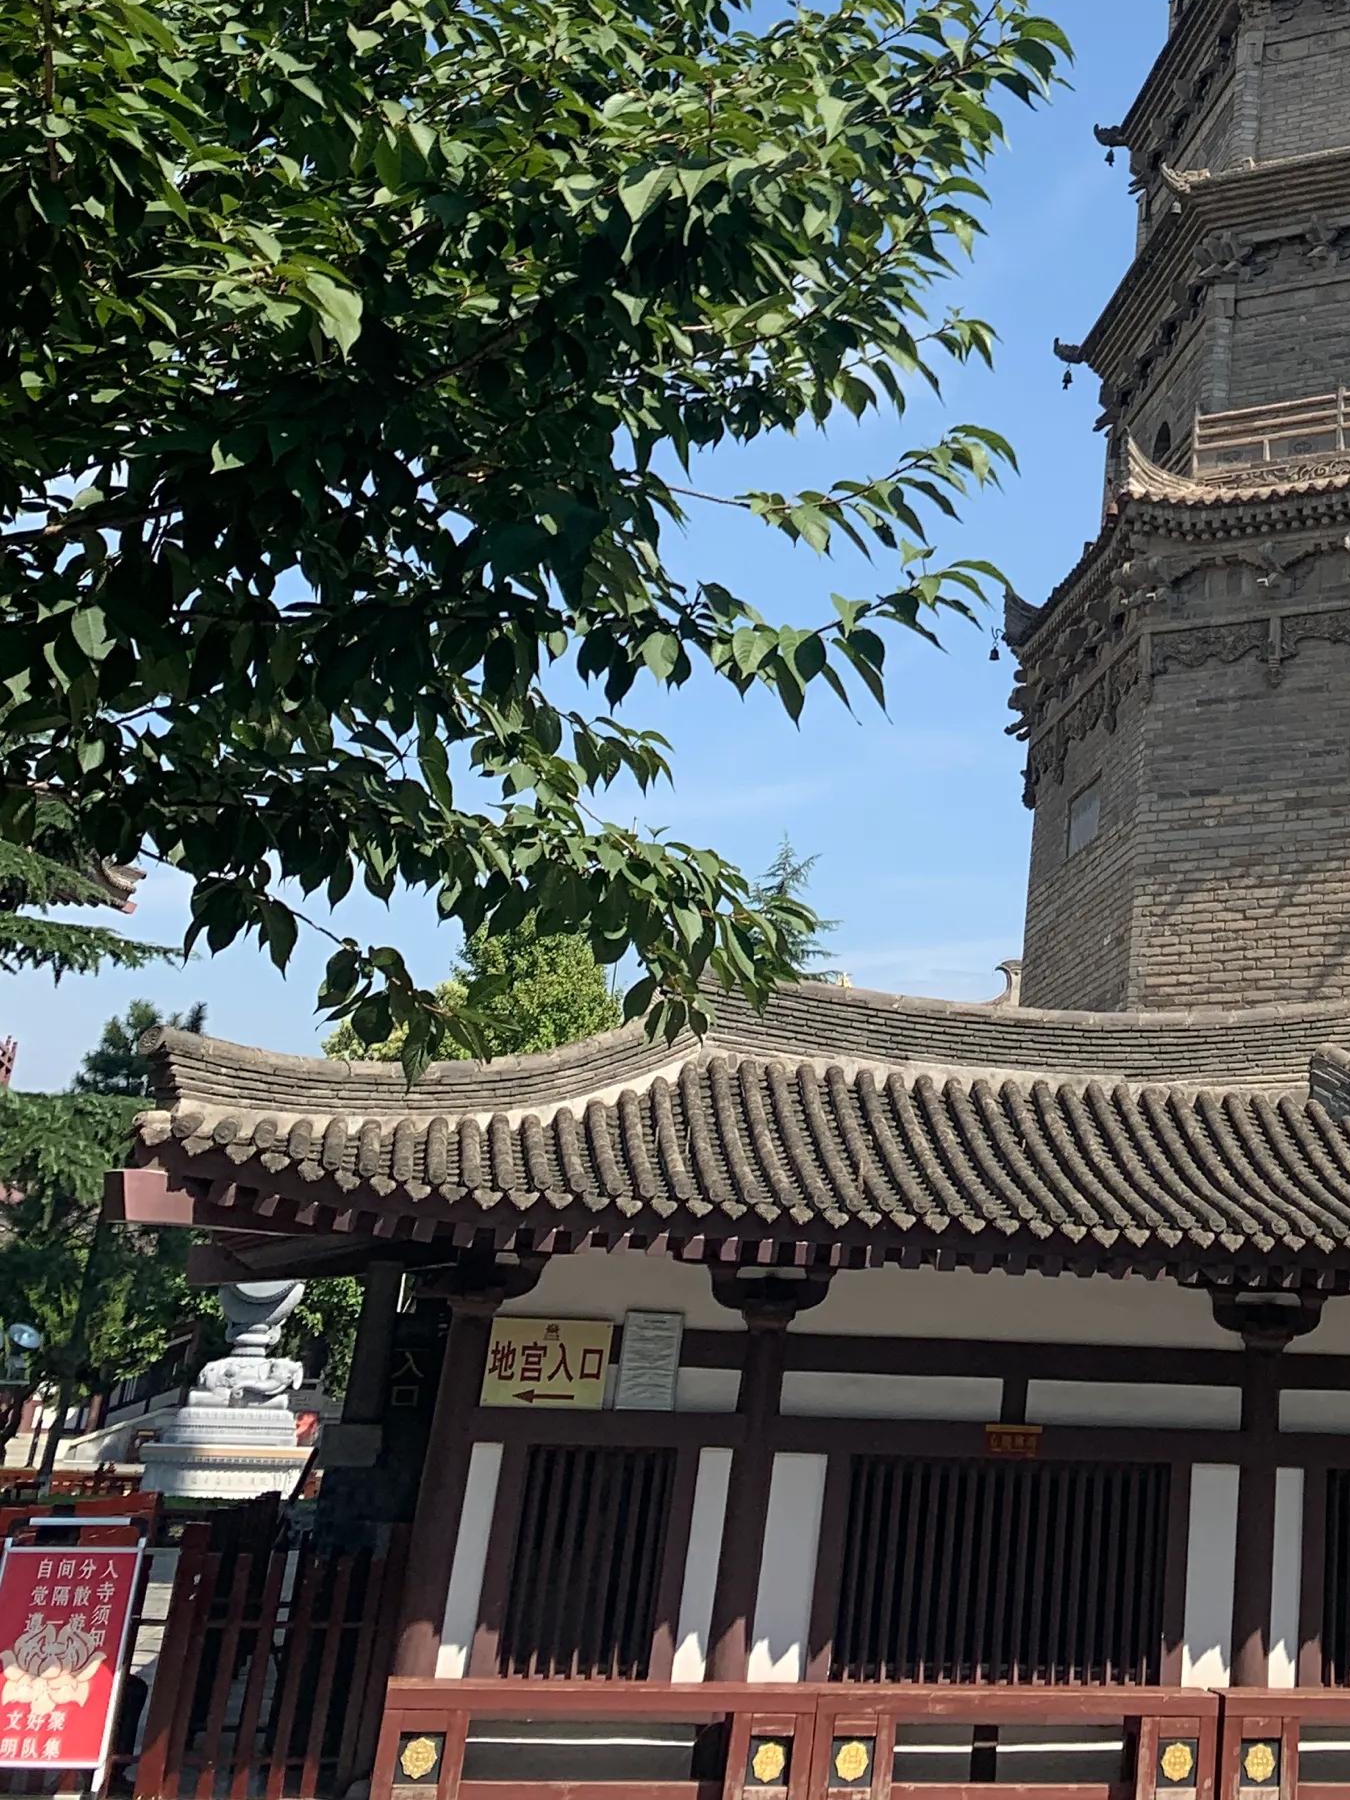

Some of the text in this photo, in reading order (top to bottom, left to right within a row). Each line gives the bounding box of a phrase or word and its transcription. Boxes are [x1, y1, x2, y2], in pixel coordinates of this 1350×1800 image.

[488, 1341, 604, 1383] 地宫入口
[88, 1559, 119, 1647] 入寺须知
